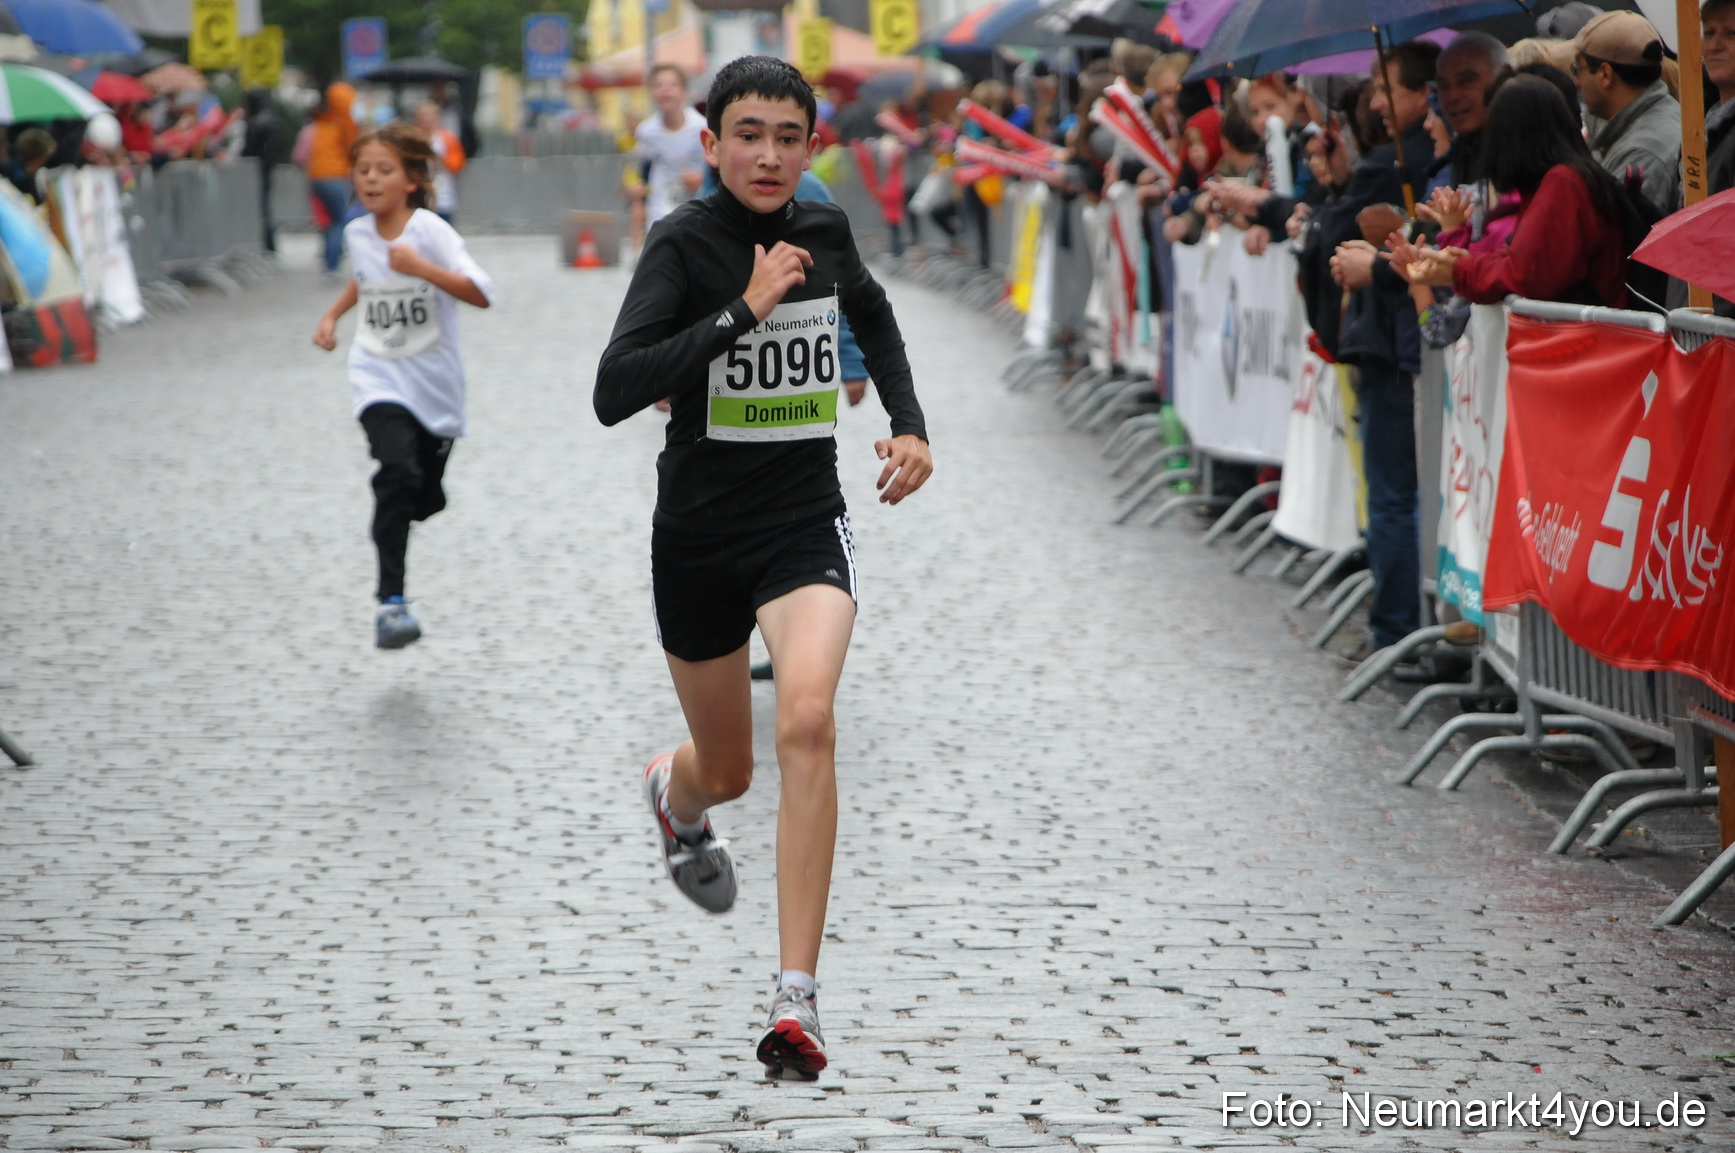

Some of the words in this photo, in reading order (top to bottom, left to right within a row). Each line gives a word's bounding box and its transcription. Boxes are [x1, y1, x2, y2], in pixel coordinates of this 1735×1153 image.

[365, 297, 427, 329] 4046
[764, 315, 824, 333] Neumarkt
[725, 333, 835, 391] 5096
[744, 399, 820, 423] Dominik
